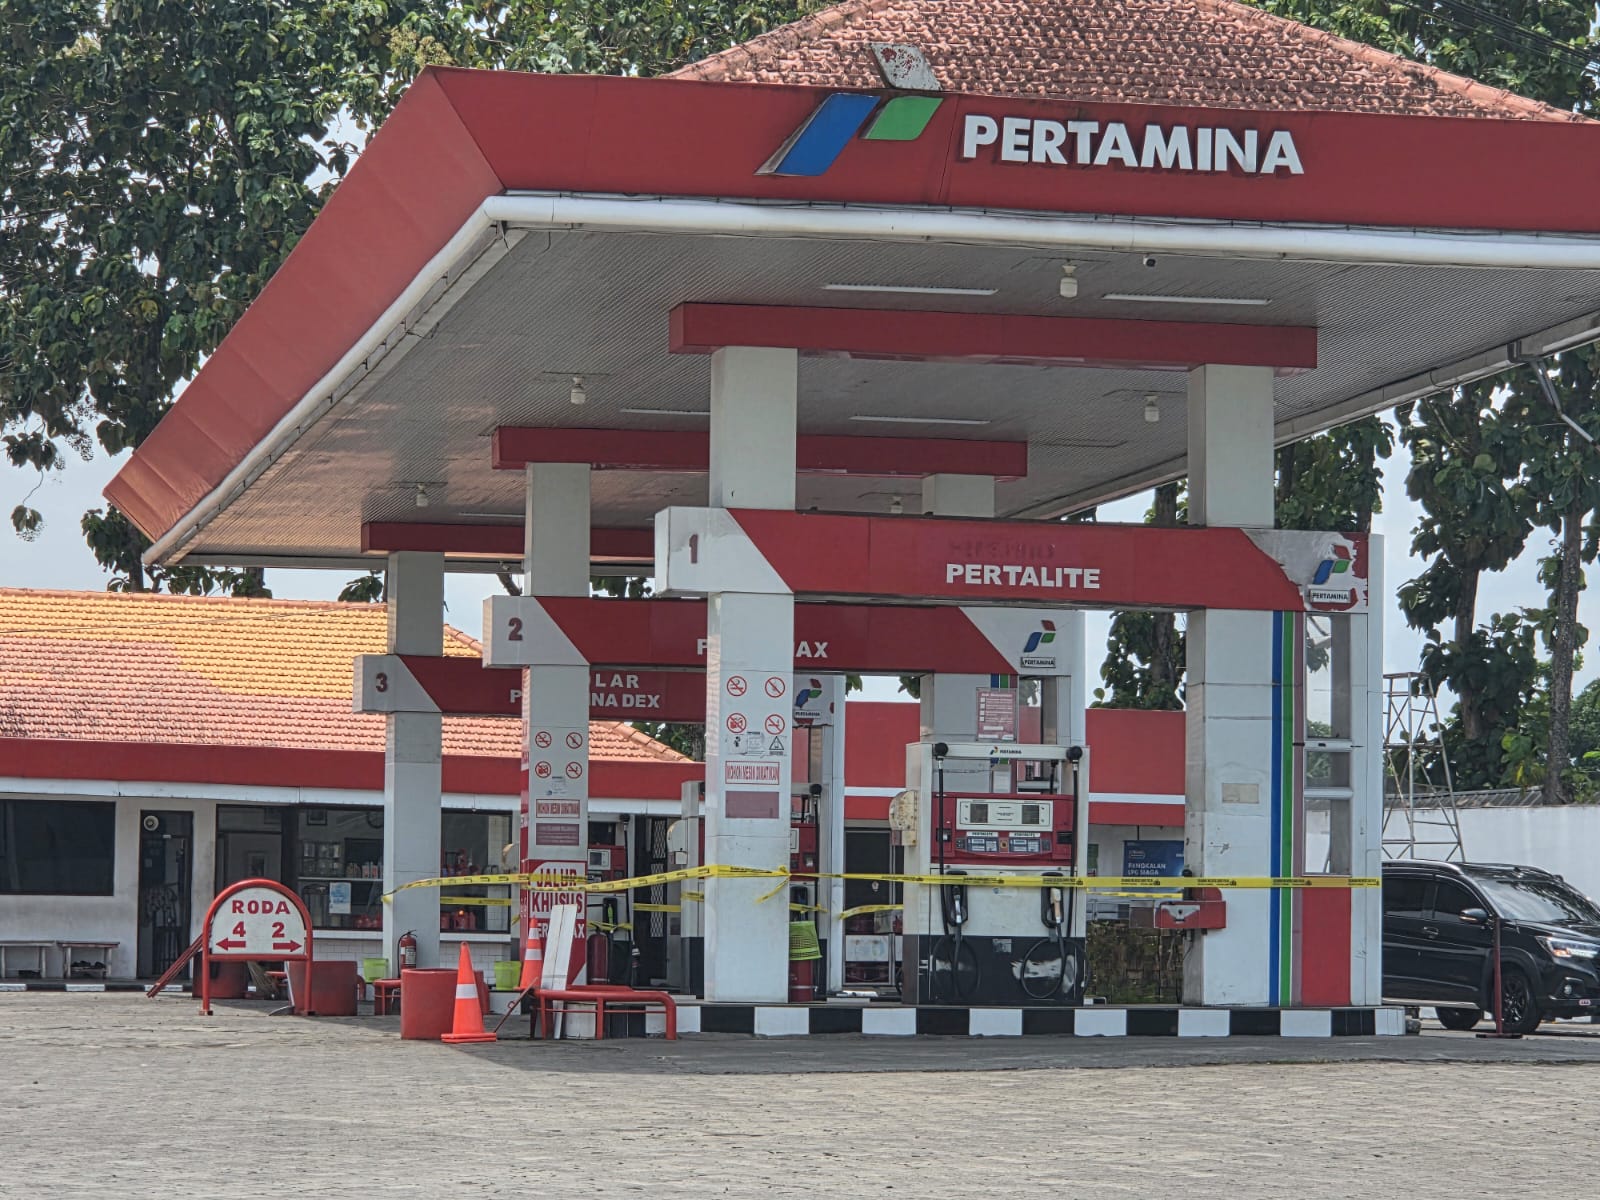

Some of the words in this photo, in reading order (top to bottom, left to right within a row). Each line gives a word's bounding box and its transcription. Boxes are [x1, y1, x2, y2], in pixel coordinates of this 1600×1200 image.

[962, 114, 1304, 175] PERTAMINA
[689, 533, 698, 564] 1
[946, 563, 1101, 589] PERTALITE
[1312, 592, 1349, 600] PERTAMINA
[508, 617, 523, 641] 2
[375, 672, 388, 692] 3
[595, 673, 640, 689] LAR
[536, 868, 577, 888] JALUR
[231, 899, 291, 915] RODA
[531, 891, 583, 914] KHUSUS
[232, 921, 246, 937] 4
[271, 921, 285, 938] 2
